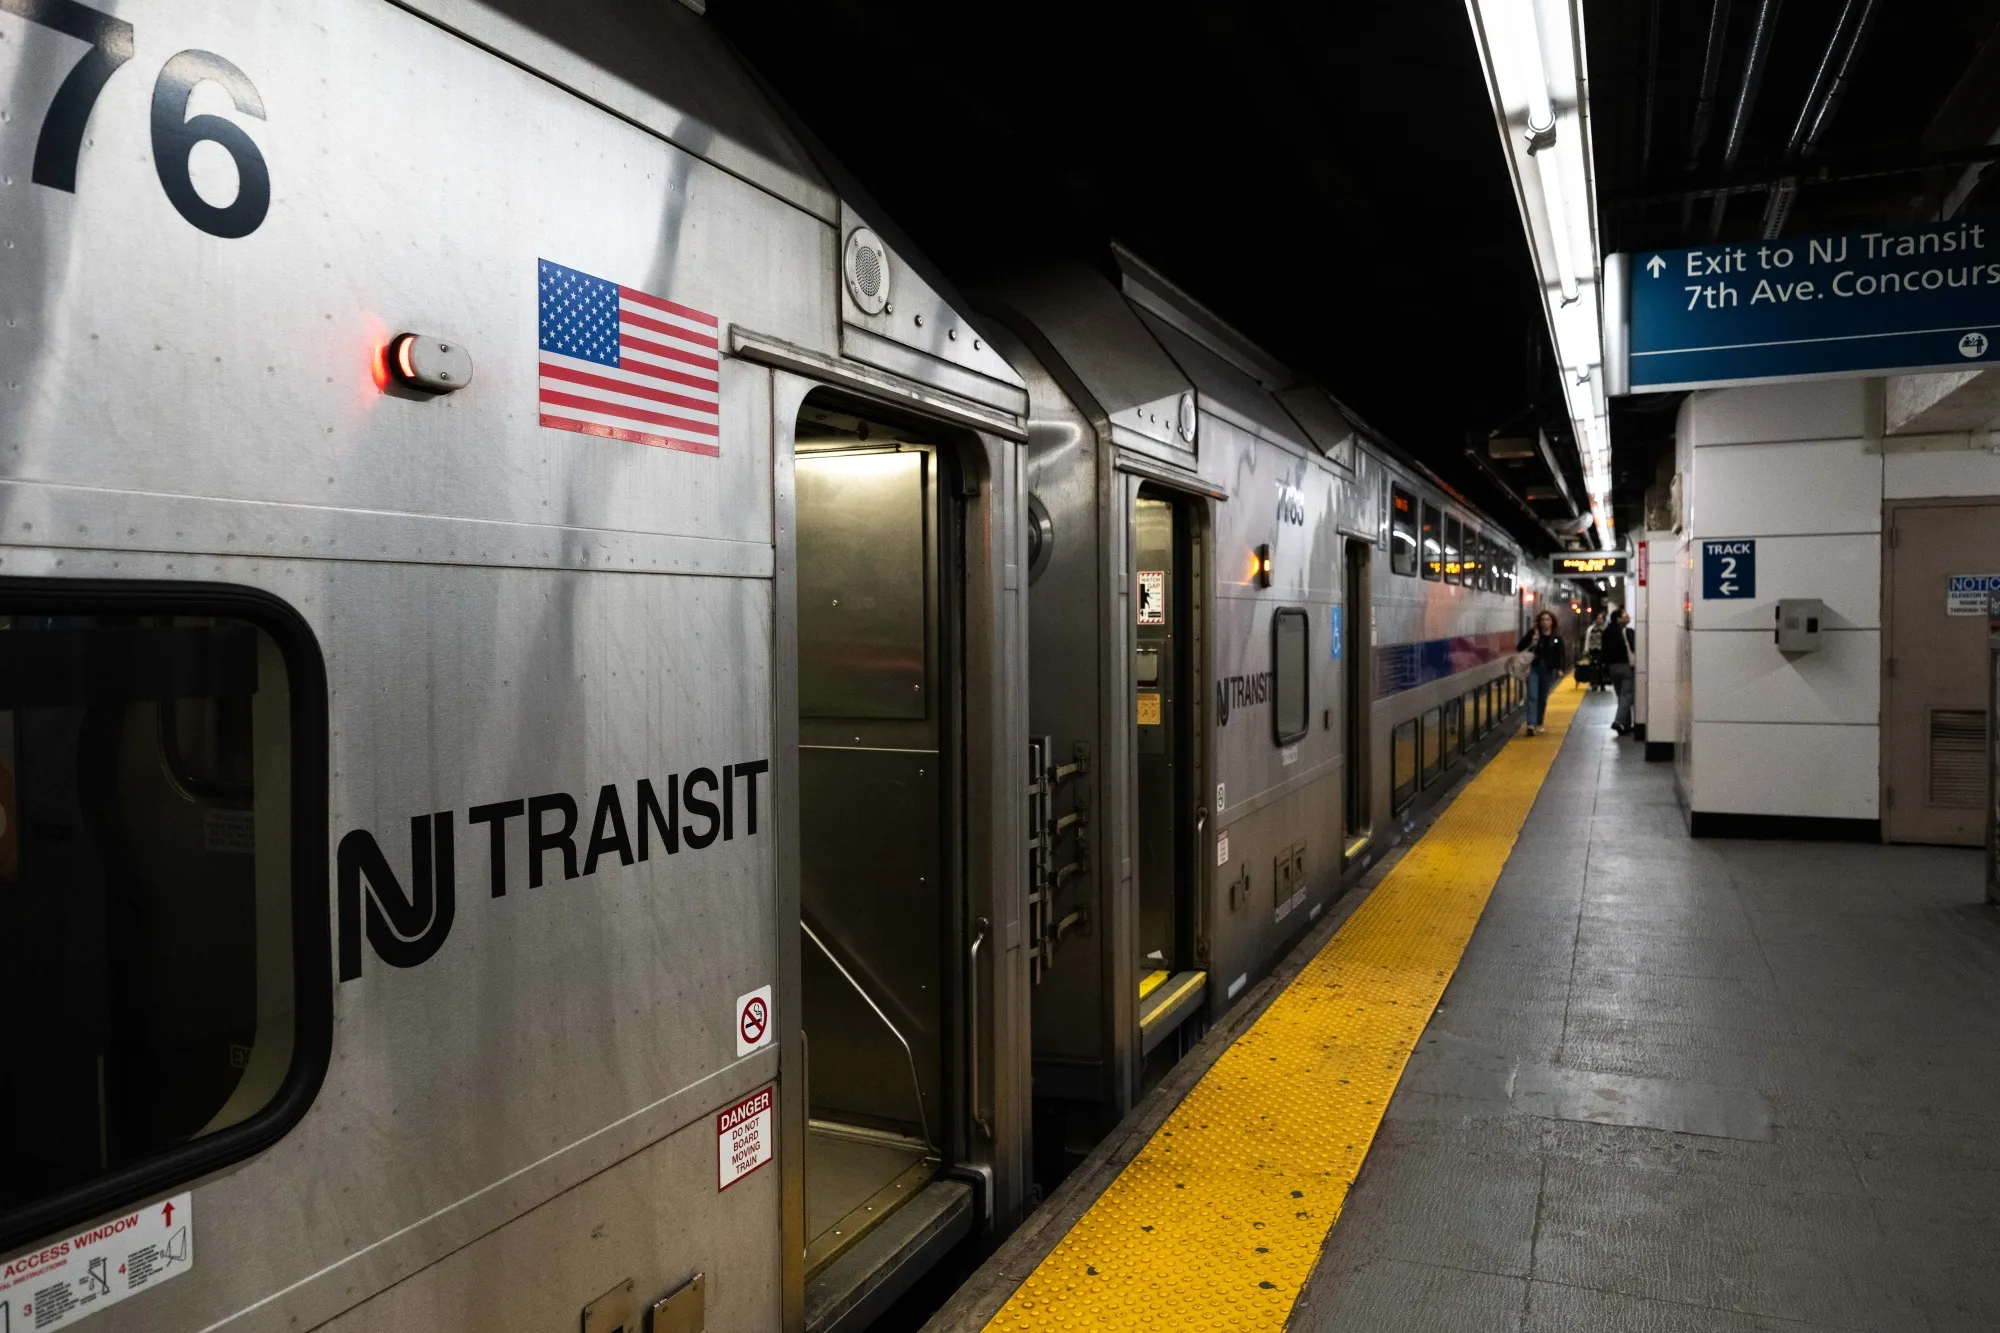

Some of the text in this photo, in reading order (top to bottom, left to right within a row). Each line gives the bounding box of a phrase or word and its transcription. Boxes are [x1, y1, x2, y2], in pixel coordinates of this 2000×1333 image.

[1687, 223, 1985, 277] Exit to NJ Transit
[1685, 264, 2000, 311] 7th Ave. Concours
[1706, 543, 1750, 555] TRACK
[1720, 557, 1737, 579] 2
[1216, 678, 1229, 727] NJ
[337, 759, 769, 982] NJ TRANSIT
[721, 1092, 769, 1131] DANGER
[732, 1117, 760, 1140] DO NOT
[733, 1130, 759, 1152] BOARD
[732, 1141, 760, 1165] MOVING
[736, 1155, 757, 1174] TRAIN
[4, 1214, 139, 1278] ACCESS WINDOW
[118, 1263, 126, 1274] 4
[23, 1303, 33, 1317] 3
